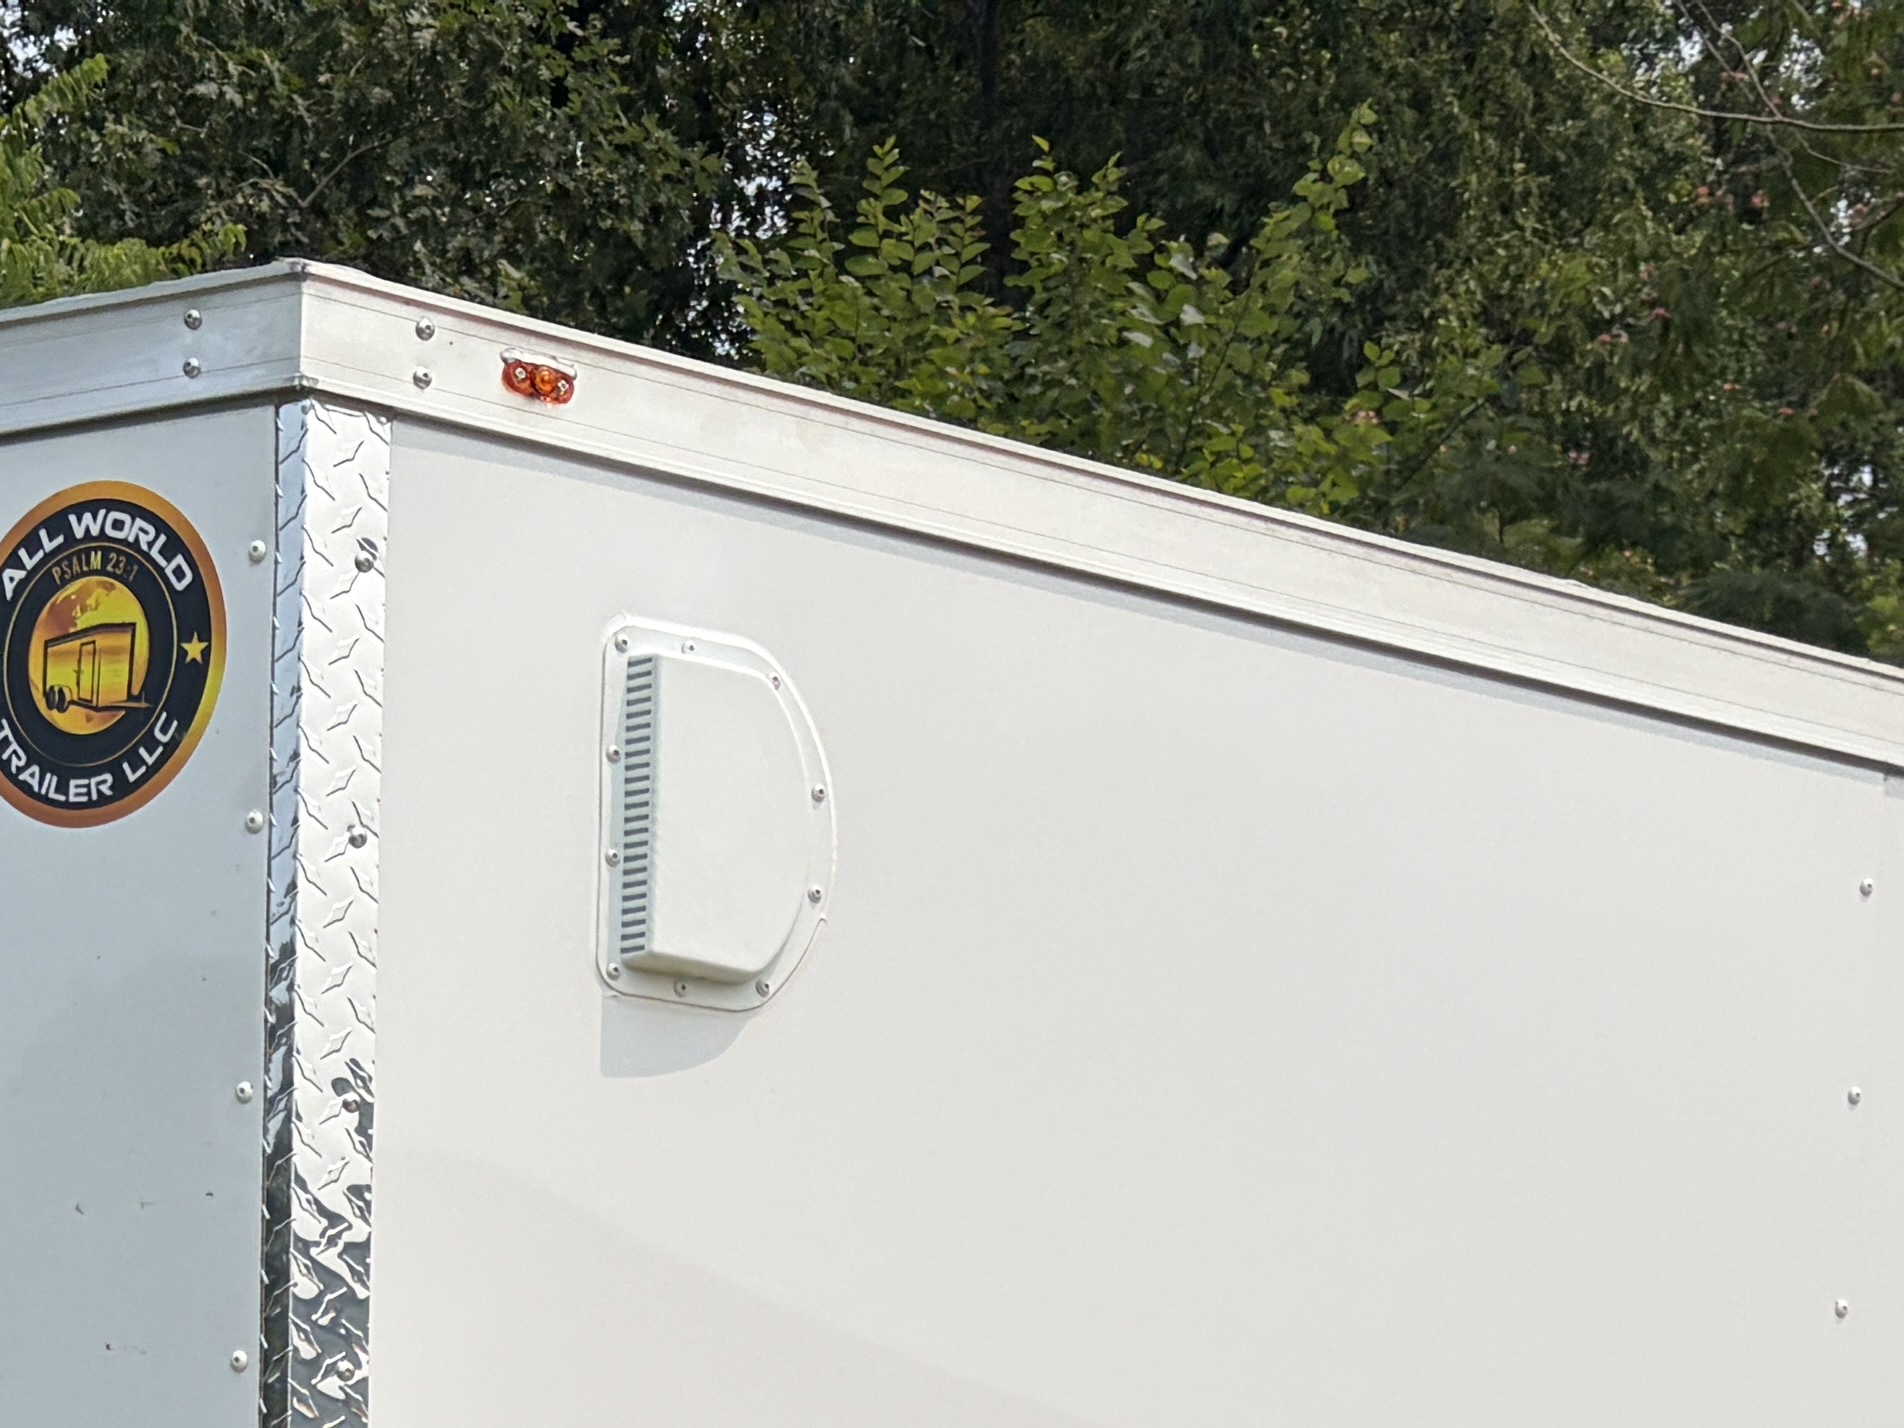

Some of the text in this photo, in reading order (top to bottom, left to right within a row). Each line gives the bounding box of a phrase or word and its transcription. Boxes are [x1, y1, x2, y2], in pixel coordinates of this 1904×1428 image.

[0, 508, 194, 601] ALL WORLD
[52, 550, 102, 585] PSALM
[122, 711, 178, 783] LLC
